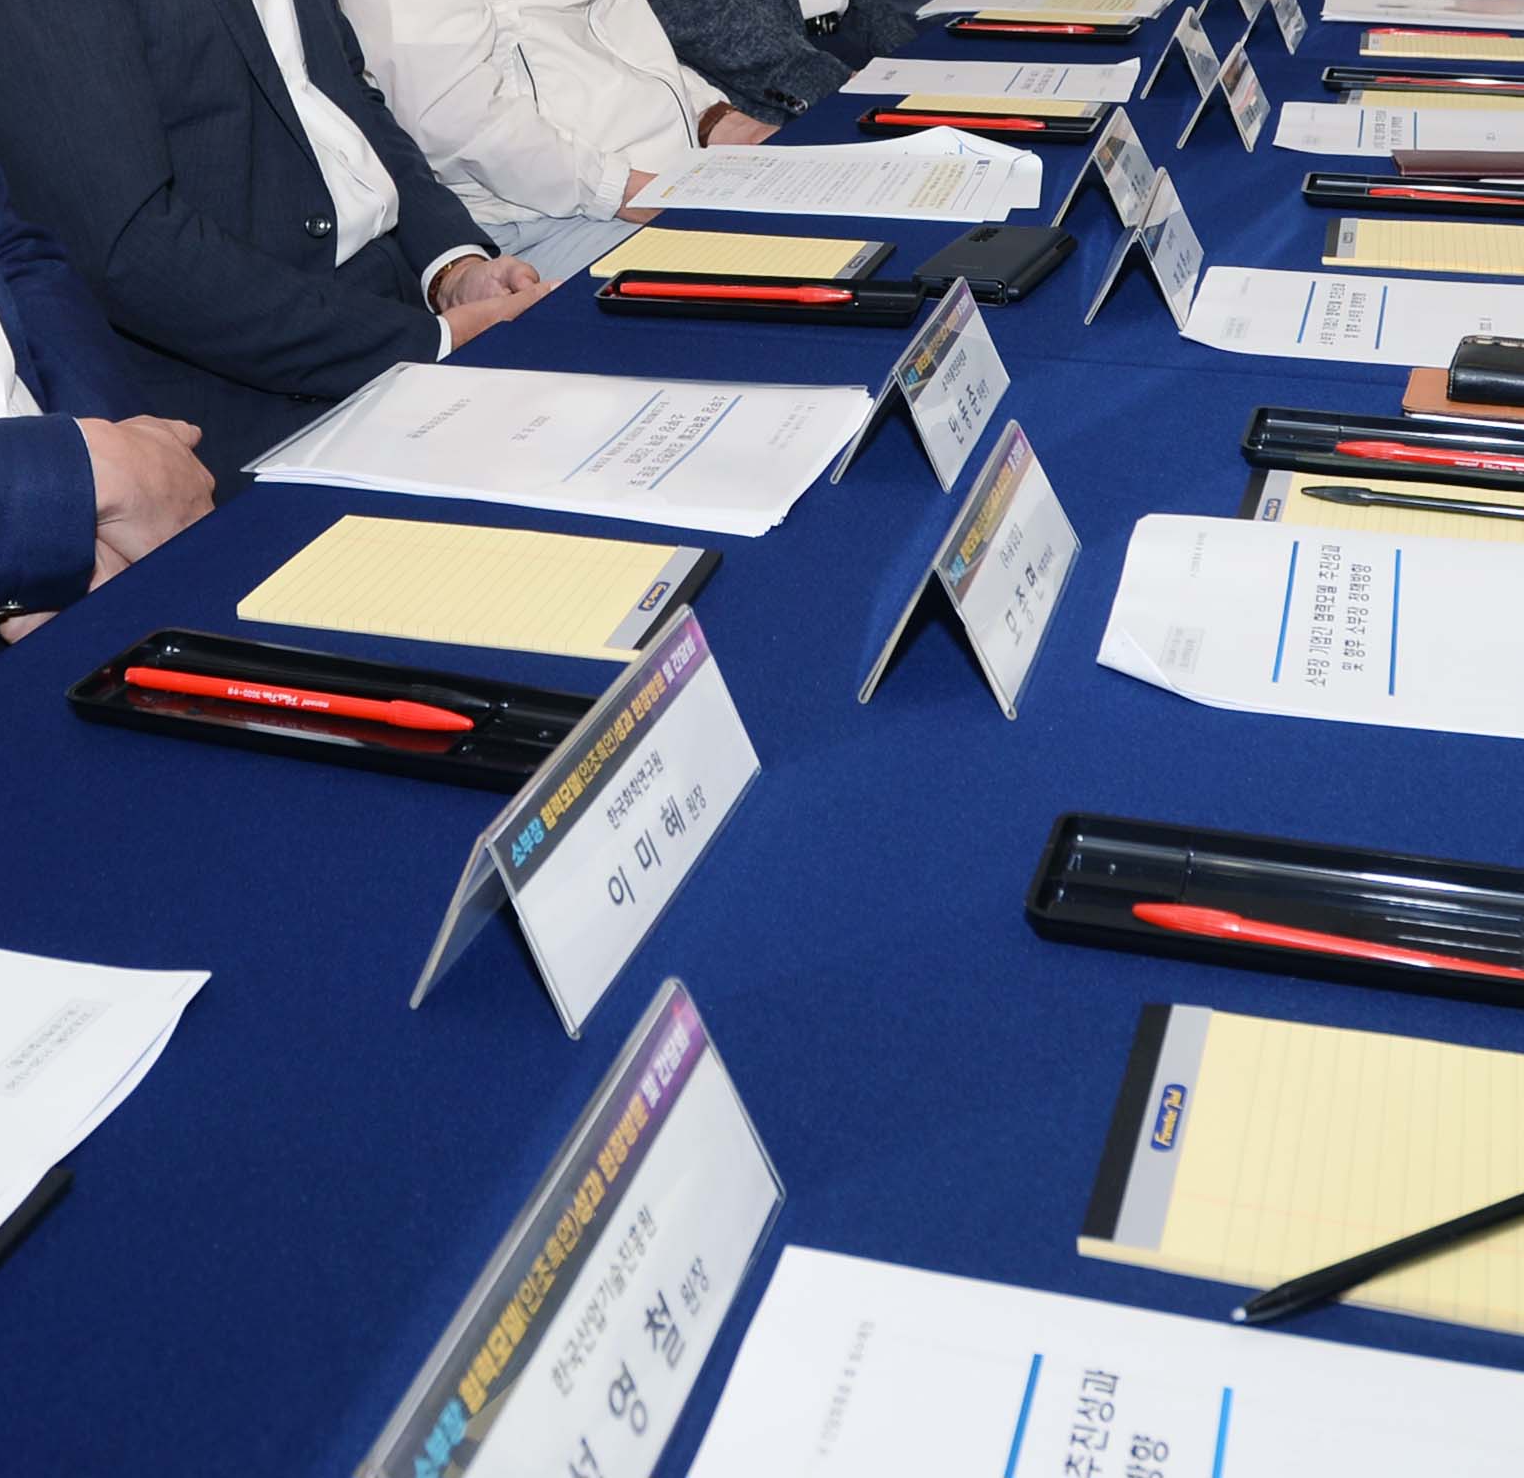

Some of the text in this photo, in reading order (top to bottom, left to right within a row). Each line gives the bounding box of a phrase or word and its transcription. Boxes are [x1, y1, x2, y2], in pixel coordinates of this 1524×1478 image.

[1306, 545, 1341, 687] 소부장 기업간 협력모델 추진성과
[1342, 564, 1372, 672] 및 향후 소부장 정책방향
[511, 818, 545, 868] 소부장
[630, 671, 667, 721] 현장방문
[671, 633, 697, 673] 간담회
[606, 749, 664, 831] 한국화학연구원
[608, 783, 707, 906] 이 미 혜 원장
[599, 1090, 650, 1184] 현장방문
[653, 1022, 692, 1091] 간담회
[551, 1204, 658, 1398] 한국산업기술진흥원
[607, 1255, 710, 1437] 영 철 원장
[1065, 1369, 1119, 1478] 추진성과
